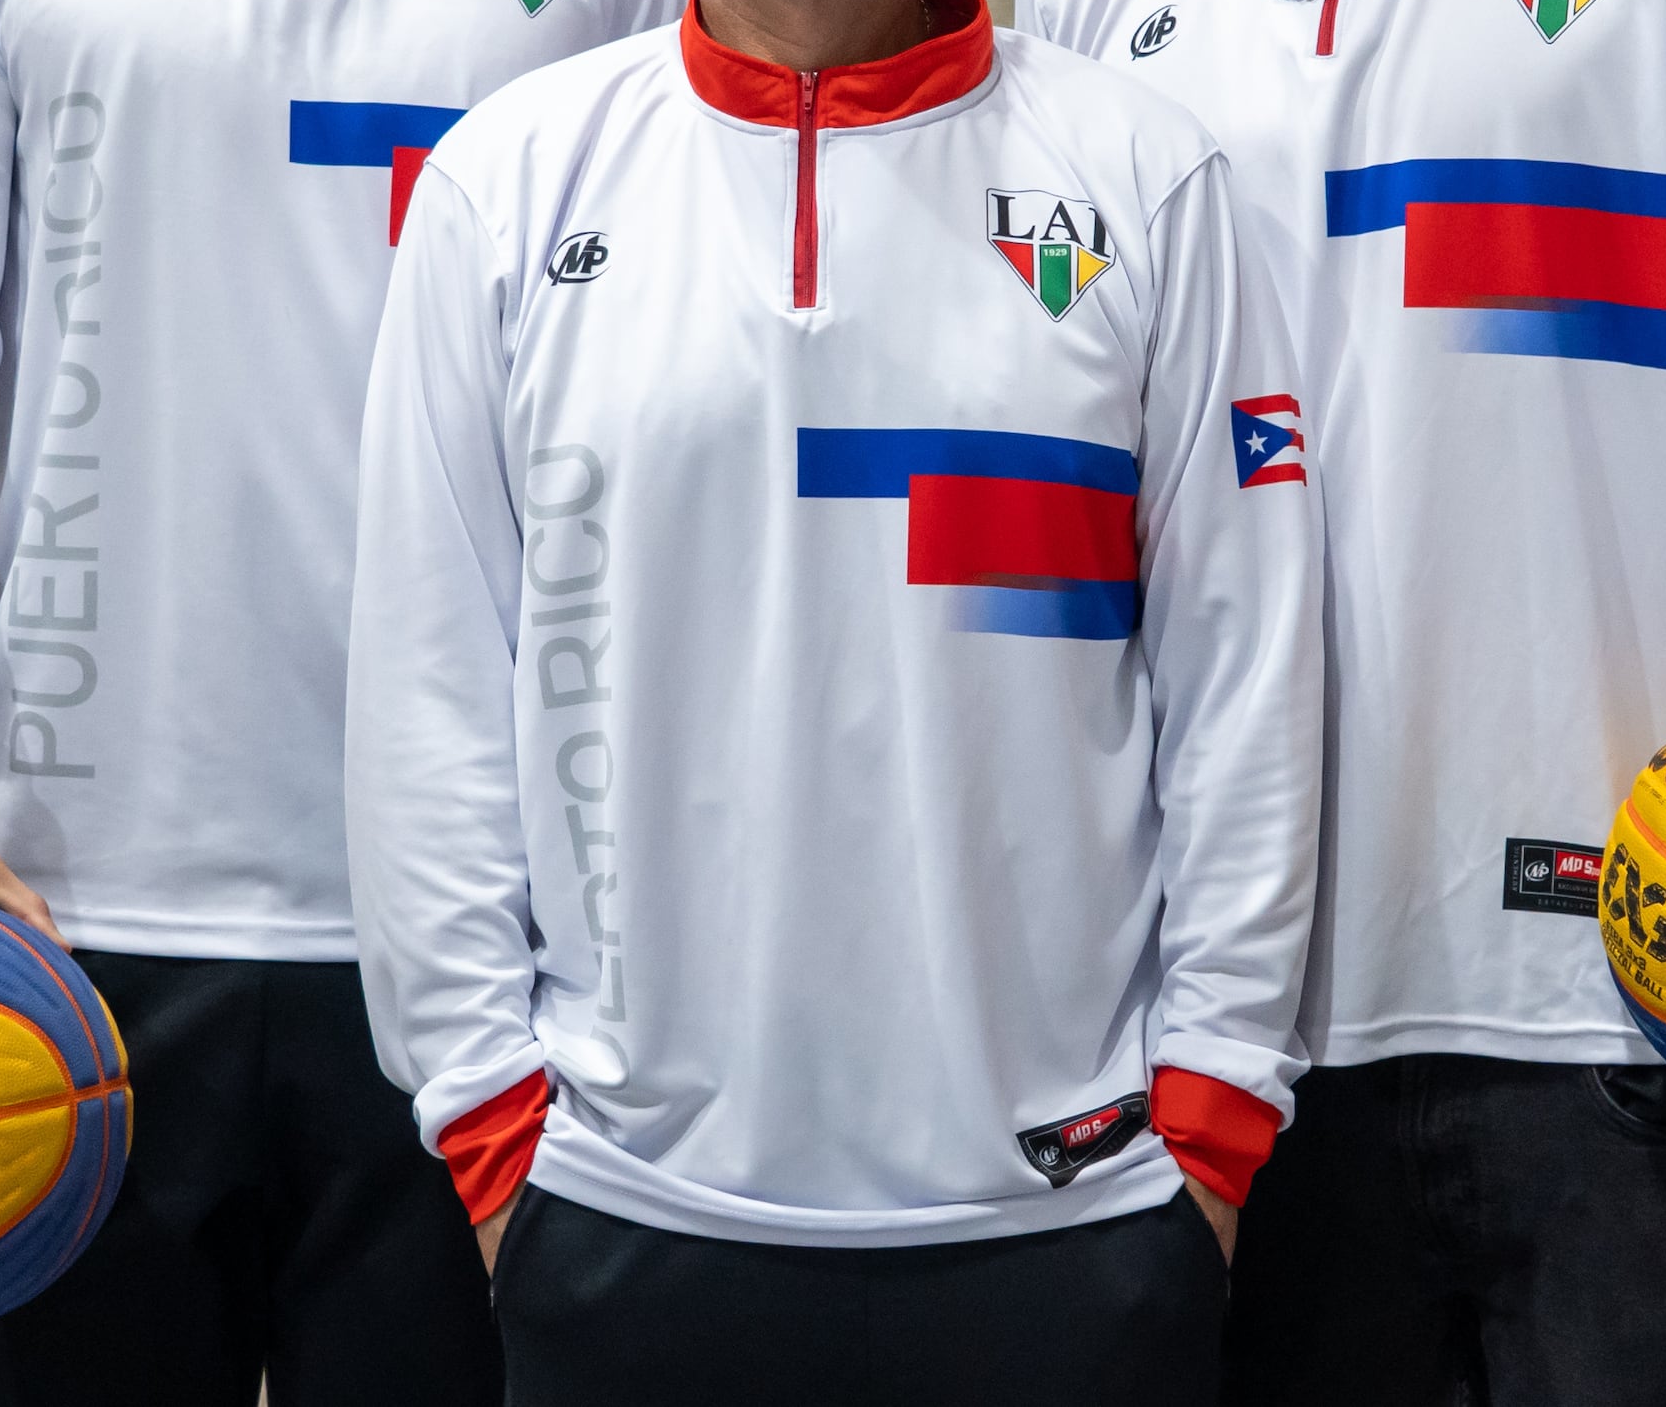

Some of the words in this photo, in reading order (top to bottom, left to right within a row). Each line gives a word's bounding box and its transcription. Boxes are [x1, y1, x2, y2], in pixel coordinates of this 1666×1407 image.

[42, 92, 106, 339] RICO
[991, 193, 1111, 258] LAI
[1043, 247, 1068, 257] 1929
[525, 443, 612, 710] RICO
[1635, 969, 1664, 1001] BALL
